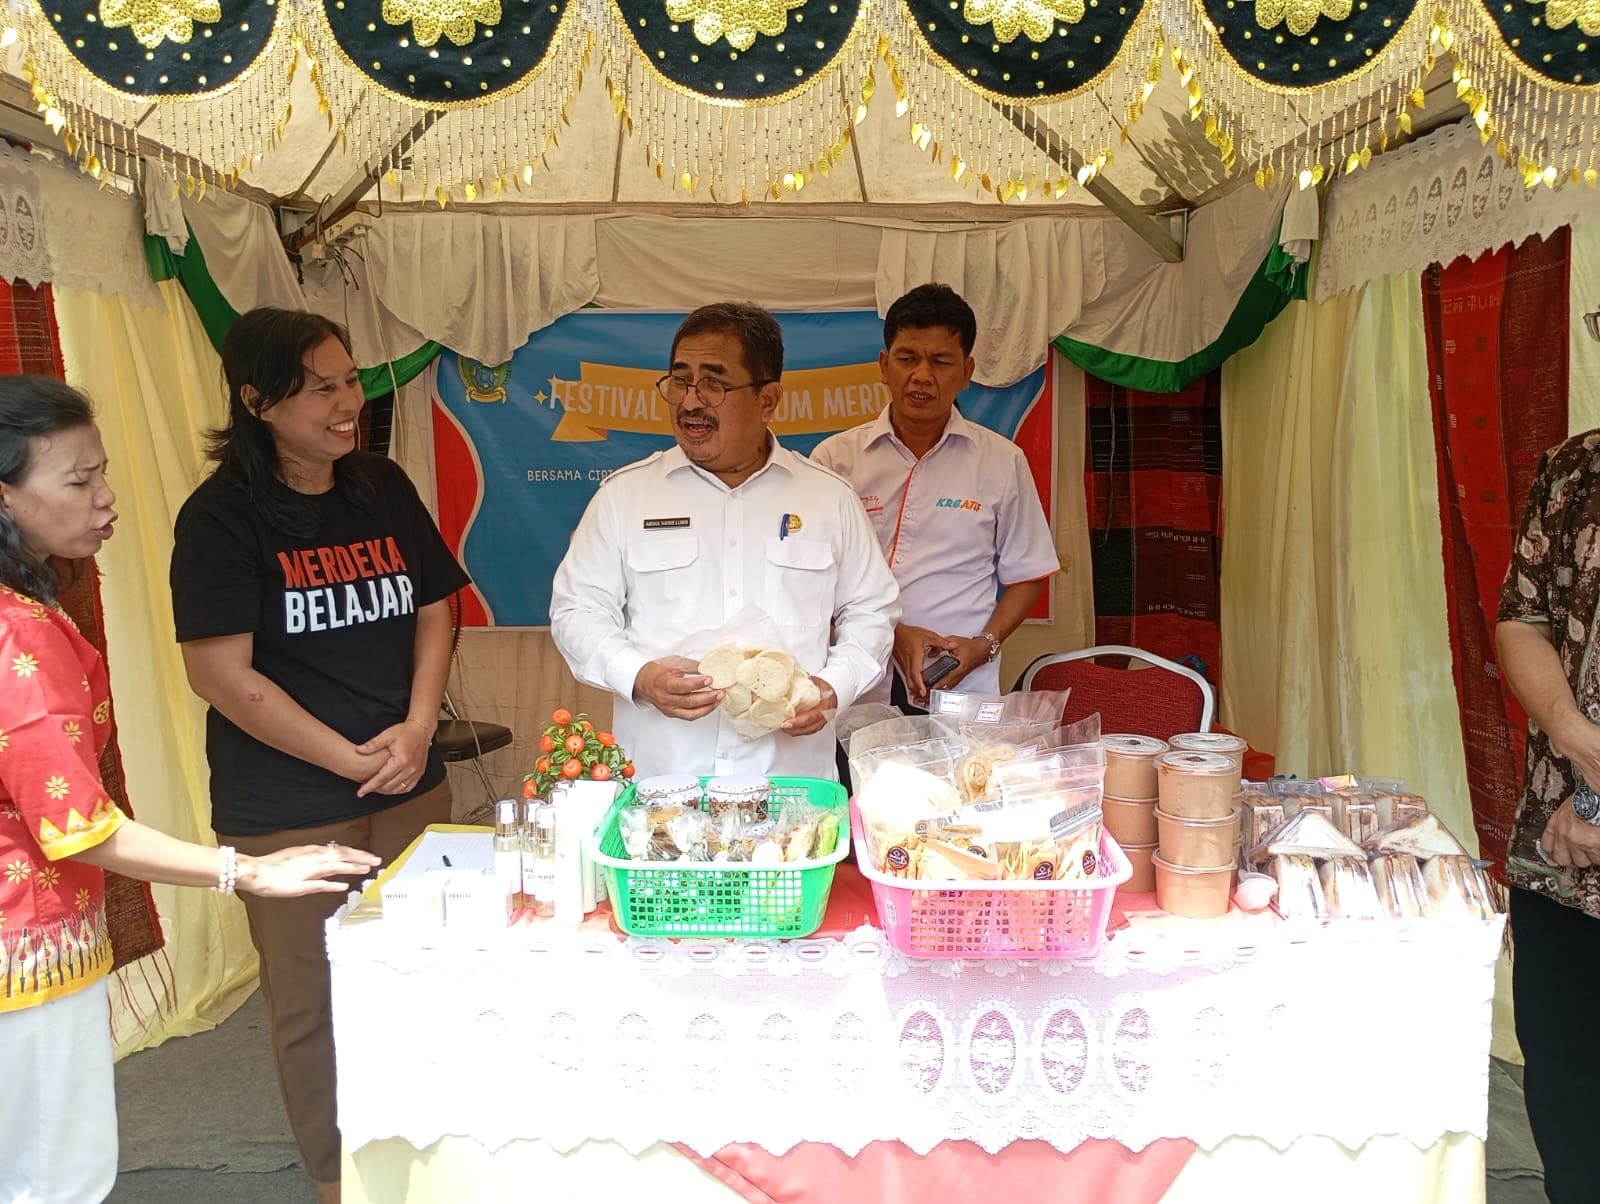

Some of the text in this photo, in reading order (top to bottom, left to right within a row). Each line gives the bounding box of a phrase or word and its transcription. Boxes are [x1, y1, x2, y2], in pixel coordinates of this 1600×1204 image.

[550, 378, 663, 421] FESTIVAL
[769, 385, 814, 423] UM
[527, 469, 582, 482] BERSAMA
[277, 536, 408, 589] MERDEKA
[284, 574, 415, 634] BELAJAR
